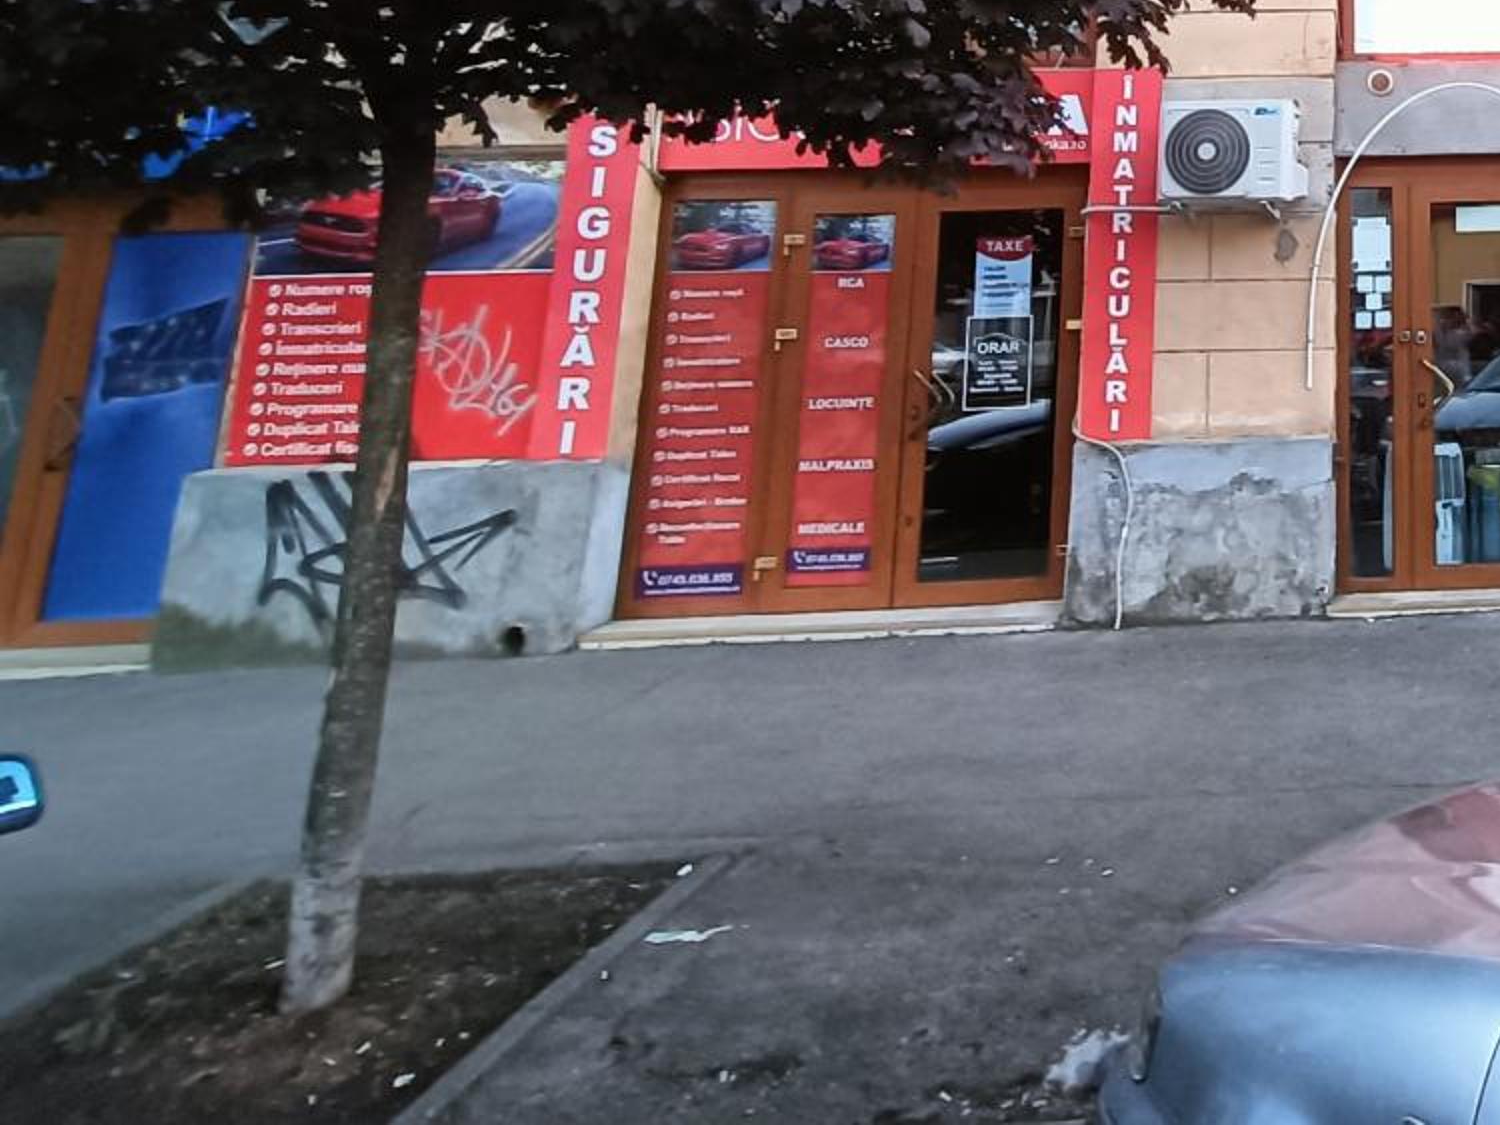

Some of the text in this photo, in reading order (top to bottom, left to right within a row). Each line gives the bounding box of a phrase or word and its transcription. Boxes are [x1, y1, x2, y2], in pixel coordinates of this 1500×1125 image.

[986, 240, 1024, 252] TAXE
[838, 278, 864, 288] RCA
[825, 337, 869, 348] CASCO
[977, 342, 1020, 354] ORAR
